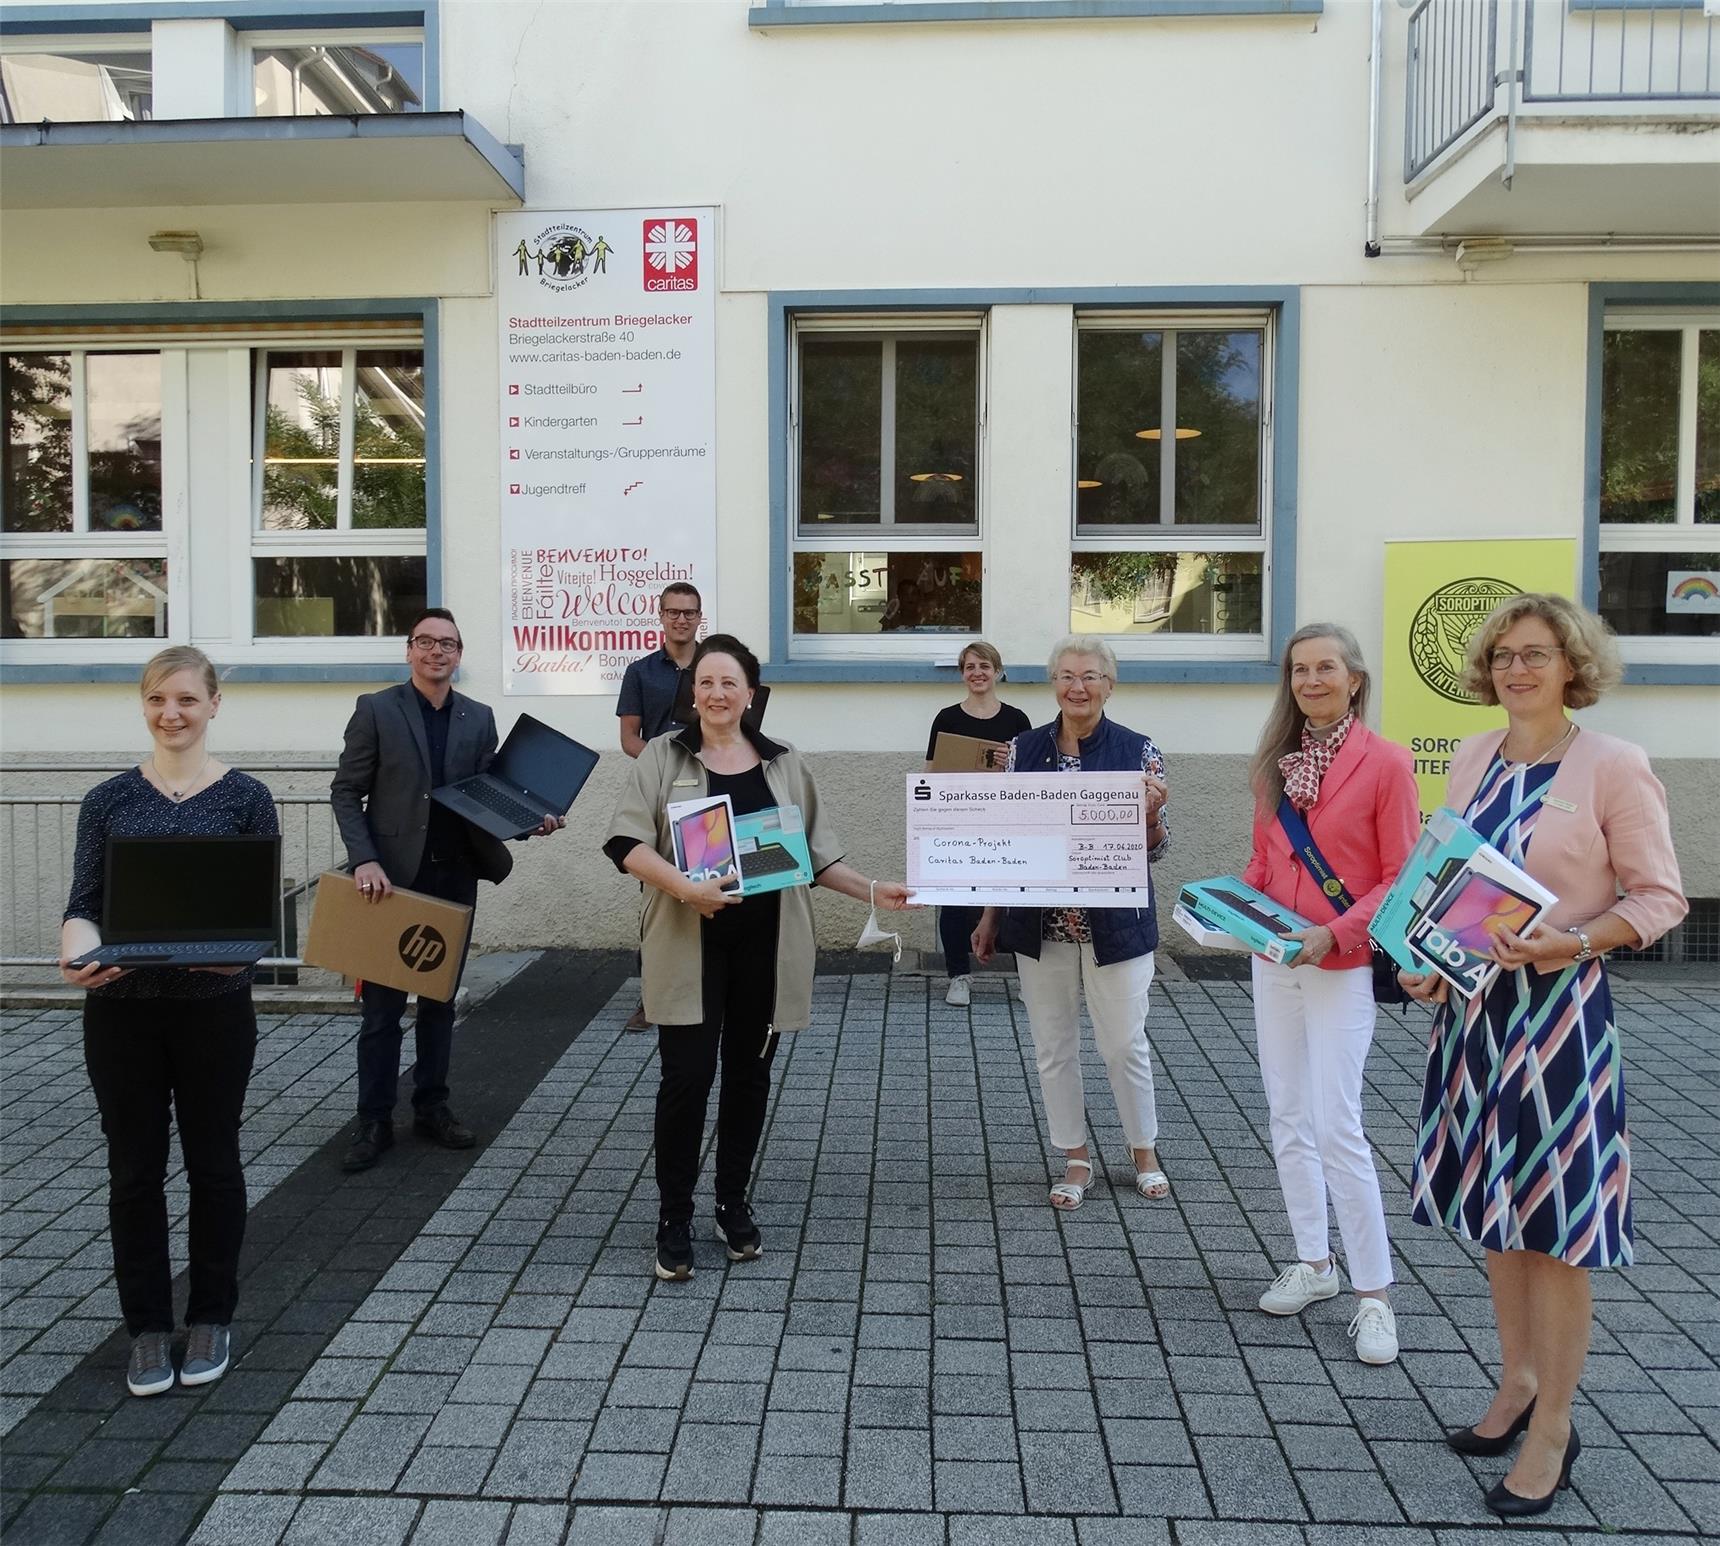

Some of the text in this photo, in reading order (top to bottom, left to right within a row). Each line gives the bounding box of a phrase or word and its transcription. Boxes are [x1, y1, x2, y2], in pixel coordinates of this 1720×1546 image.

[533, 223, 593, 245] Stadtteilzentrum
[539, 276, 589, 293] Briegelacker
[647, 276, 694, 291] caritas
[509, 313, 693, 329] Stadtteilzentrum Briegelacker
[509, 331, 635, 347] Briegelackerstraße 40
[509, 348, 681, 363] www.caritas-baden-baden.de
[523, 383, 598, 396] Stadtteilbüro
[523, 416, 598, 430] Kindergarten
[524, 446, 706, 461] Veranstaltungs-/Gruppenräume
[521, 482, 586, 497] Jugendtreff
[536, 548, 647, 563] BENVENUTO!
[599, 562, 694, 588] Hoşgeldin!
[521, 550, 533, 619] BIENVENUE
[536, 564, 554, 619] Fáilte
[1439, 597, 1504, 611] SOROPTIM
[572, 618, 622, 627] Benvenuto!
[939, 790, 997, 803] Sparkasse
[1000, 789, 1077, 801] Baden-Baden
[1080, 789, 1139, 802] Gaggenau
[933, 838, 1011, 851] Corona-Projekt
[1102, 842, 1143, 851] 17.06.2020
[969, 855, 1028, 865] Baden-Baden
[1113, 854, 1132, 862] Club
[401, 924, 444, 971] hp
[1415, 917, 1487, 987] Tab A
